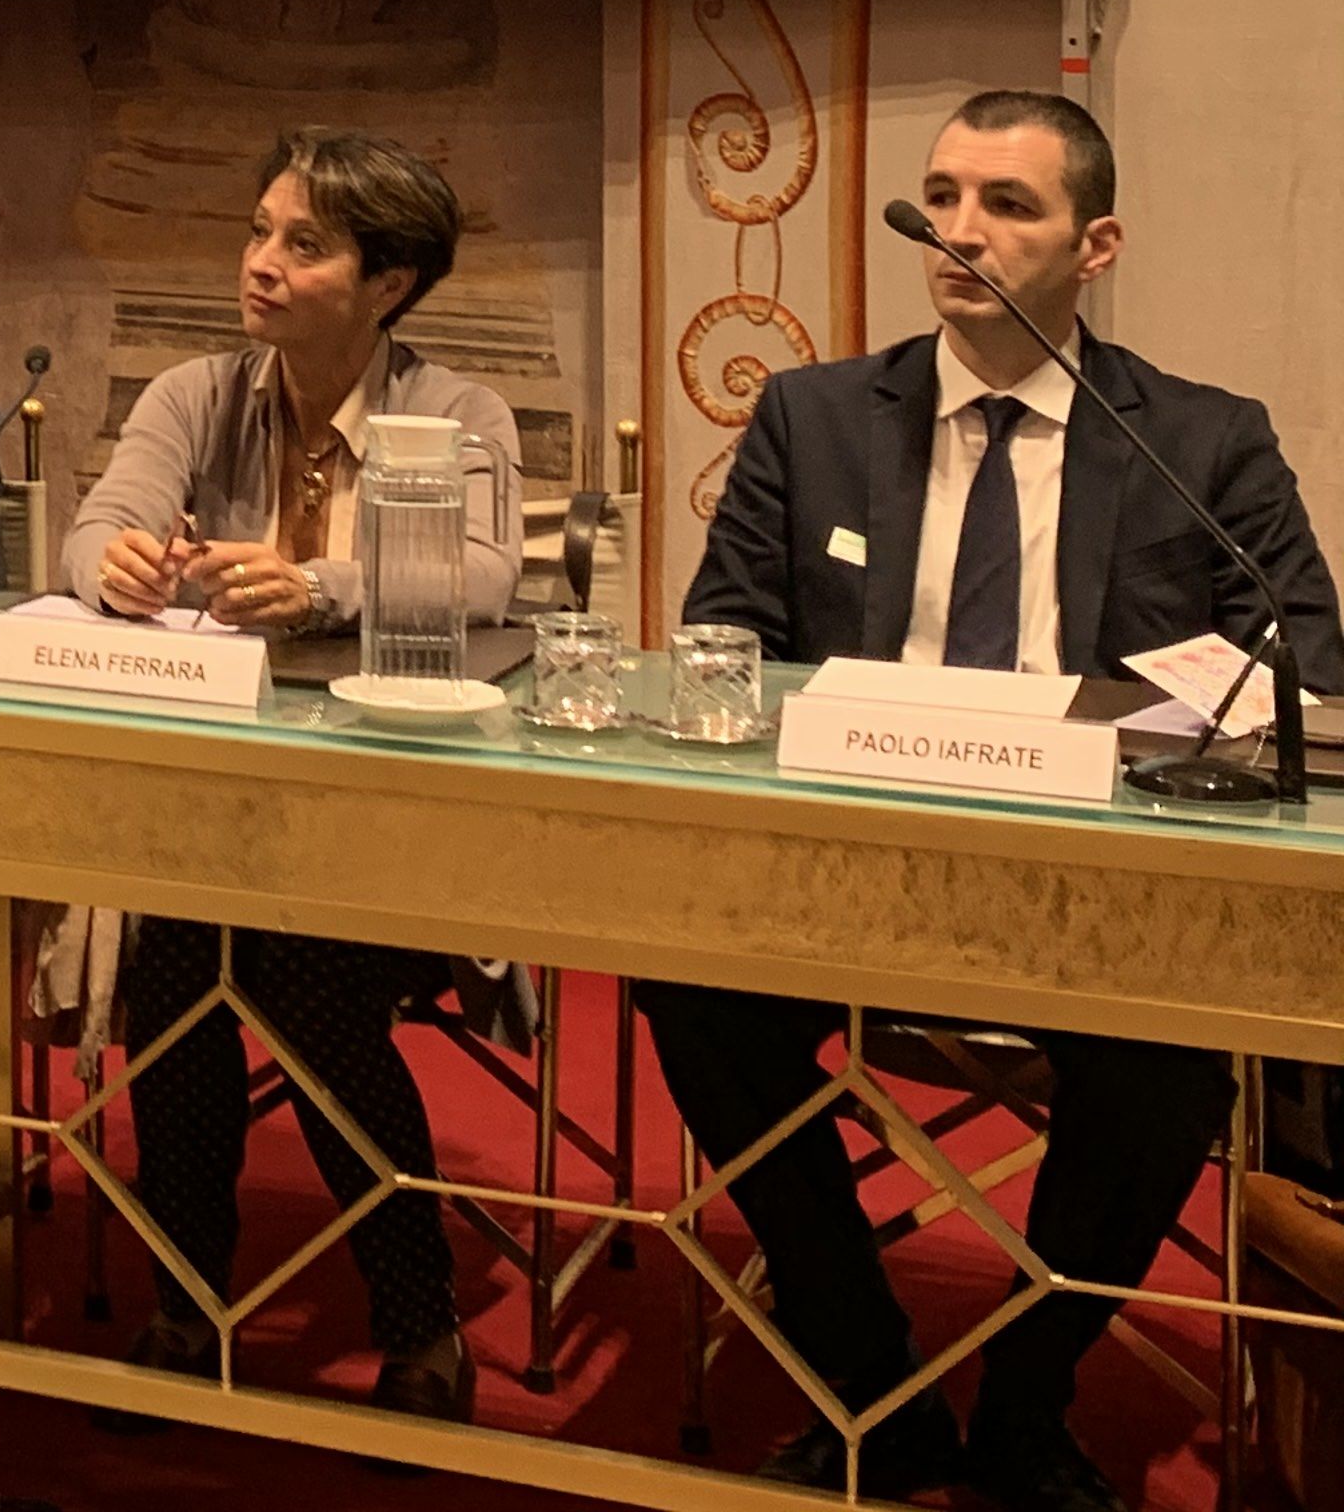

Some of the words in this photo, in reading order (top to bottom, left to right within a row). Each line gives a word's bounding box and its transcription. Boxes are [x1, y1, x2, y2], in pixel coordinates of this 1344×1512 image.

[34, 645, 100, 672] ELENA
[107, 653, 206, 683] FERRARA
[846, 730, 929, 758] PAOLO
[939, 739, 1043, 770] IAFRATE
